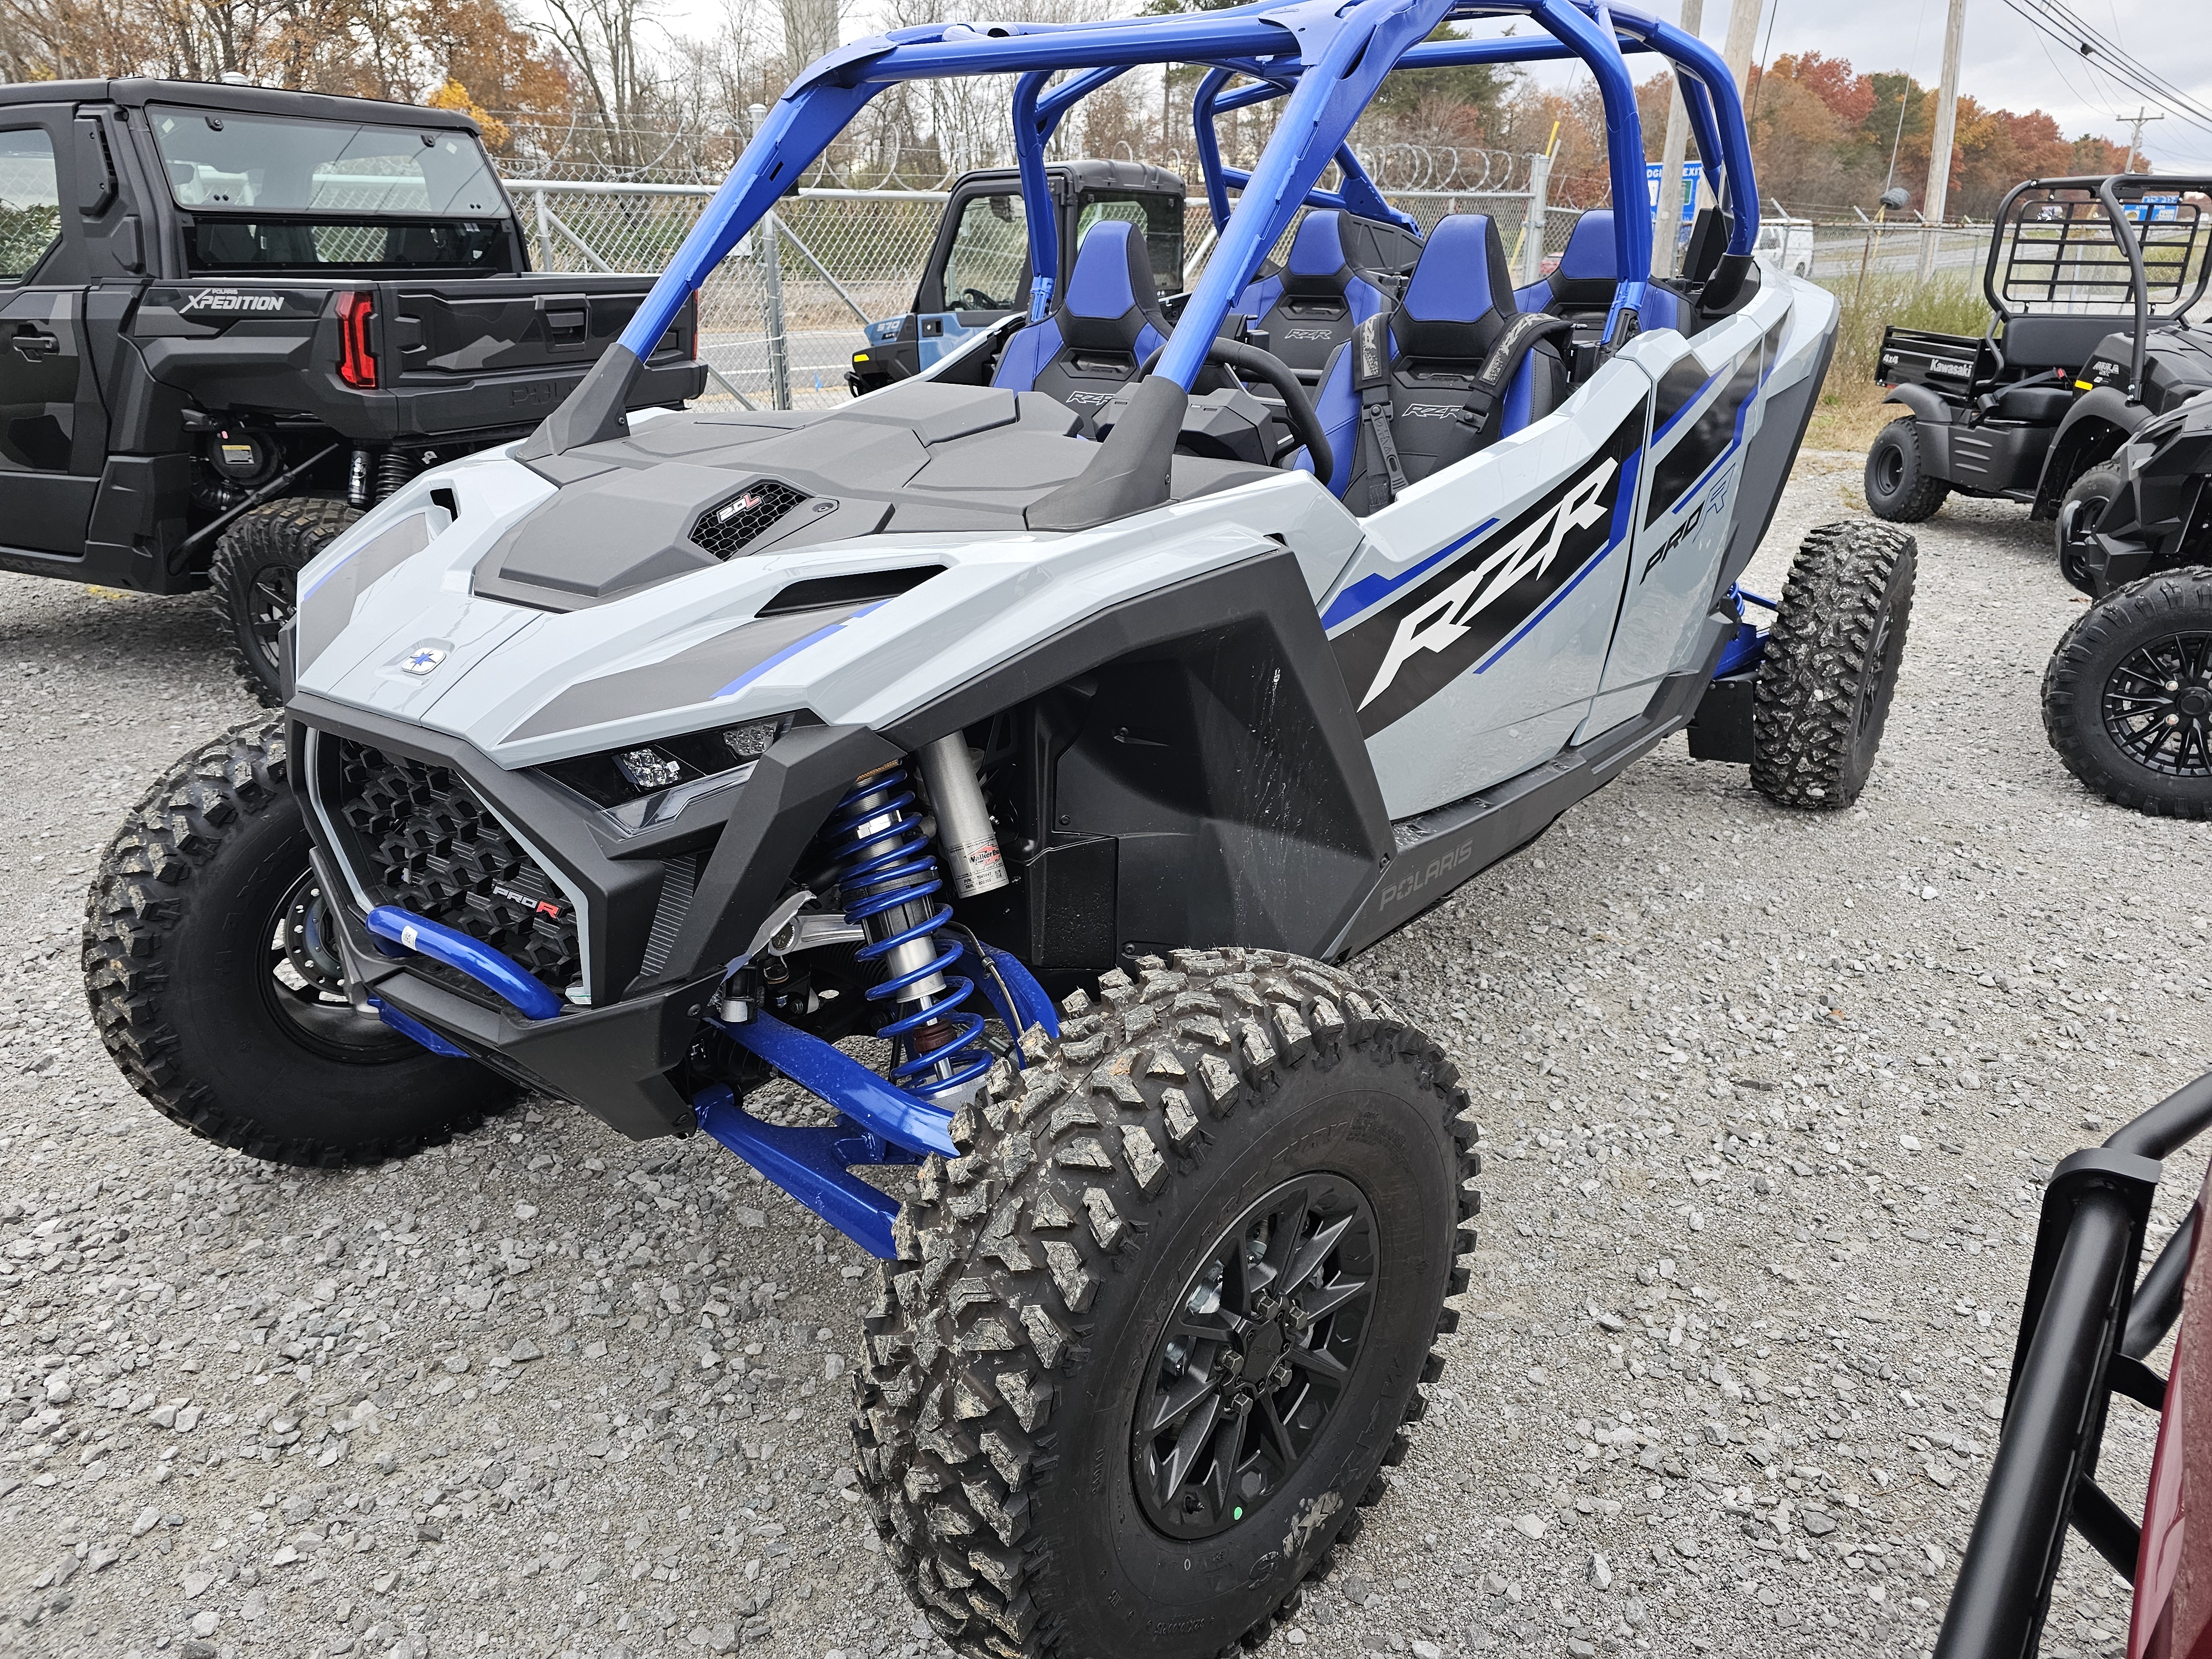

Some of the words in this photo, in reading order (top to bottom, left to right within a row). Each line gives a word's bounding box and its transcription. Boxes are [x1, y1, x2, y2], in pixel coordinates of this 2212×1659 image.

[1682, 167, 1702, 177] EXIT
[179, 289, 285, 314] XPEDITION
[877, 321, 900, 332] 570
[1285, 328, 1332, 341] RZR
[1882, 354, 1898, 364] 4x4
[1929, 359, 1973, 377] Kawasaki
[1639, 499, 1706, 586] PRO
[1692, 462, 1736, 544] R
[1357, 457, 1619, 713] RZR
[968, 852, 992, 863] Walker
[1379, 837, 1474, 912] POLARIS
[492, 886, 538, 909] PRO
[536, 901, 559, 919] R
